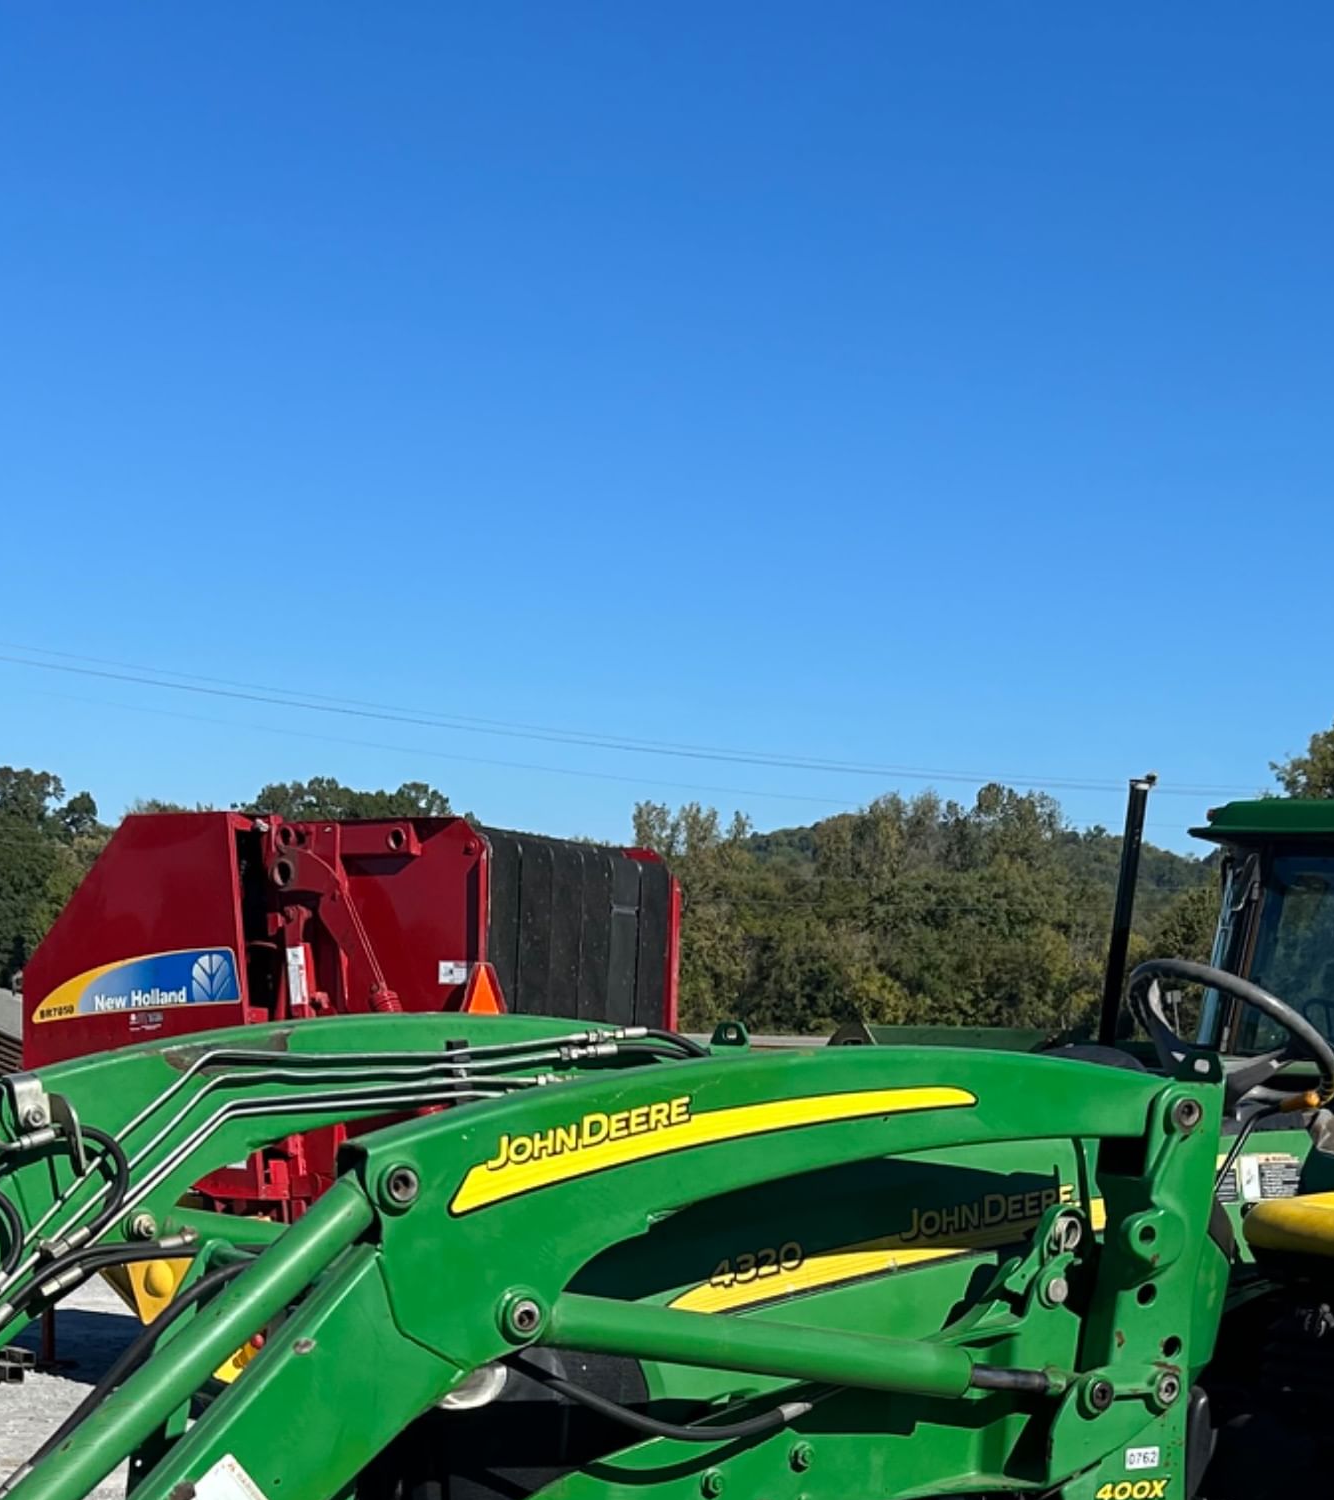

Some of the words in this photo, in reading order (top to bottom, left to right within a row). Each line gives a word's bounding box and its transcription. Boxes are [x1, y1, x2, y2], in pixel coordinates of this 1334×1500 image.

[94, 995, 127, 1011] New
[130, 986, 188, 1008] Holland
[487, 1124, 578, 1169] JOHN
[581, 1096, 691, 1147] DEERE
[899, 1206, 981, 1241] JOHN
[982, 1184, 1081, 1225] DEERE
[710, 1241, 805, 1288] 4320
[1128, 1450, 1157, 1466] 0762
